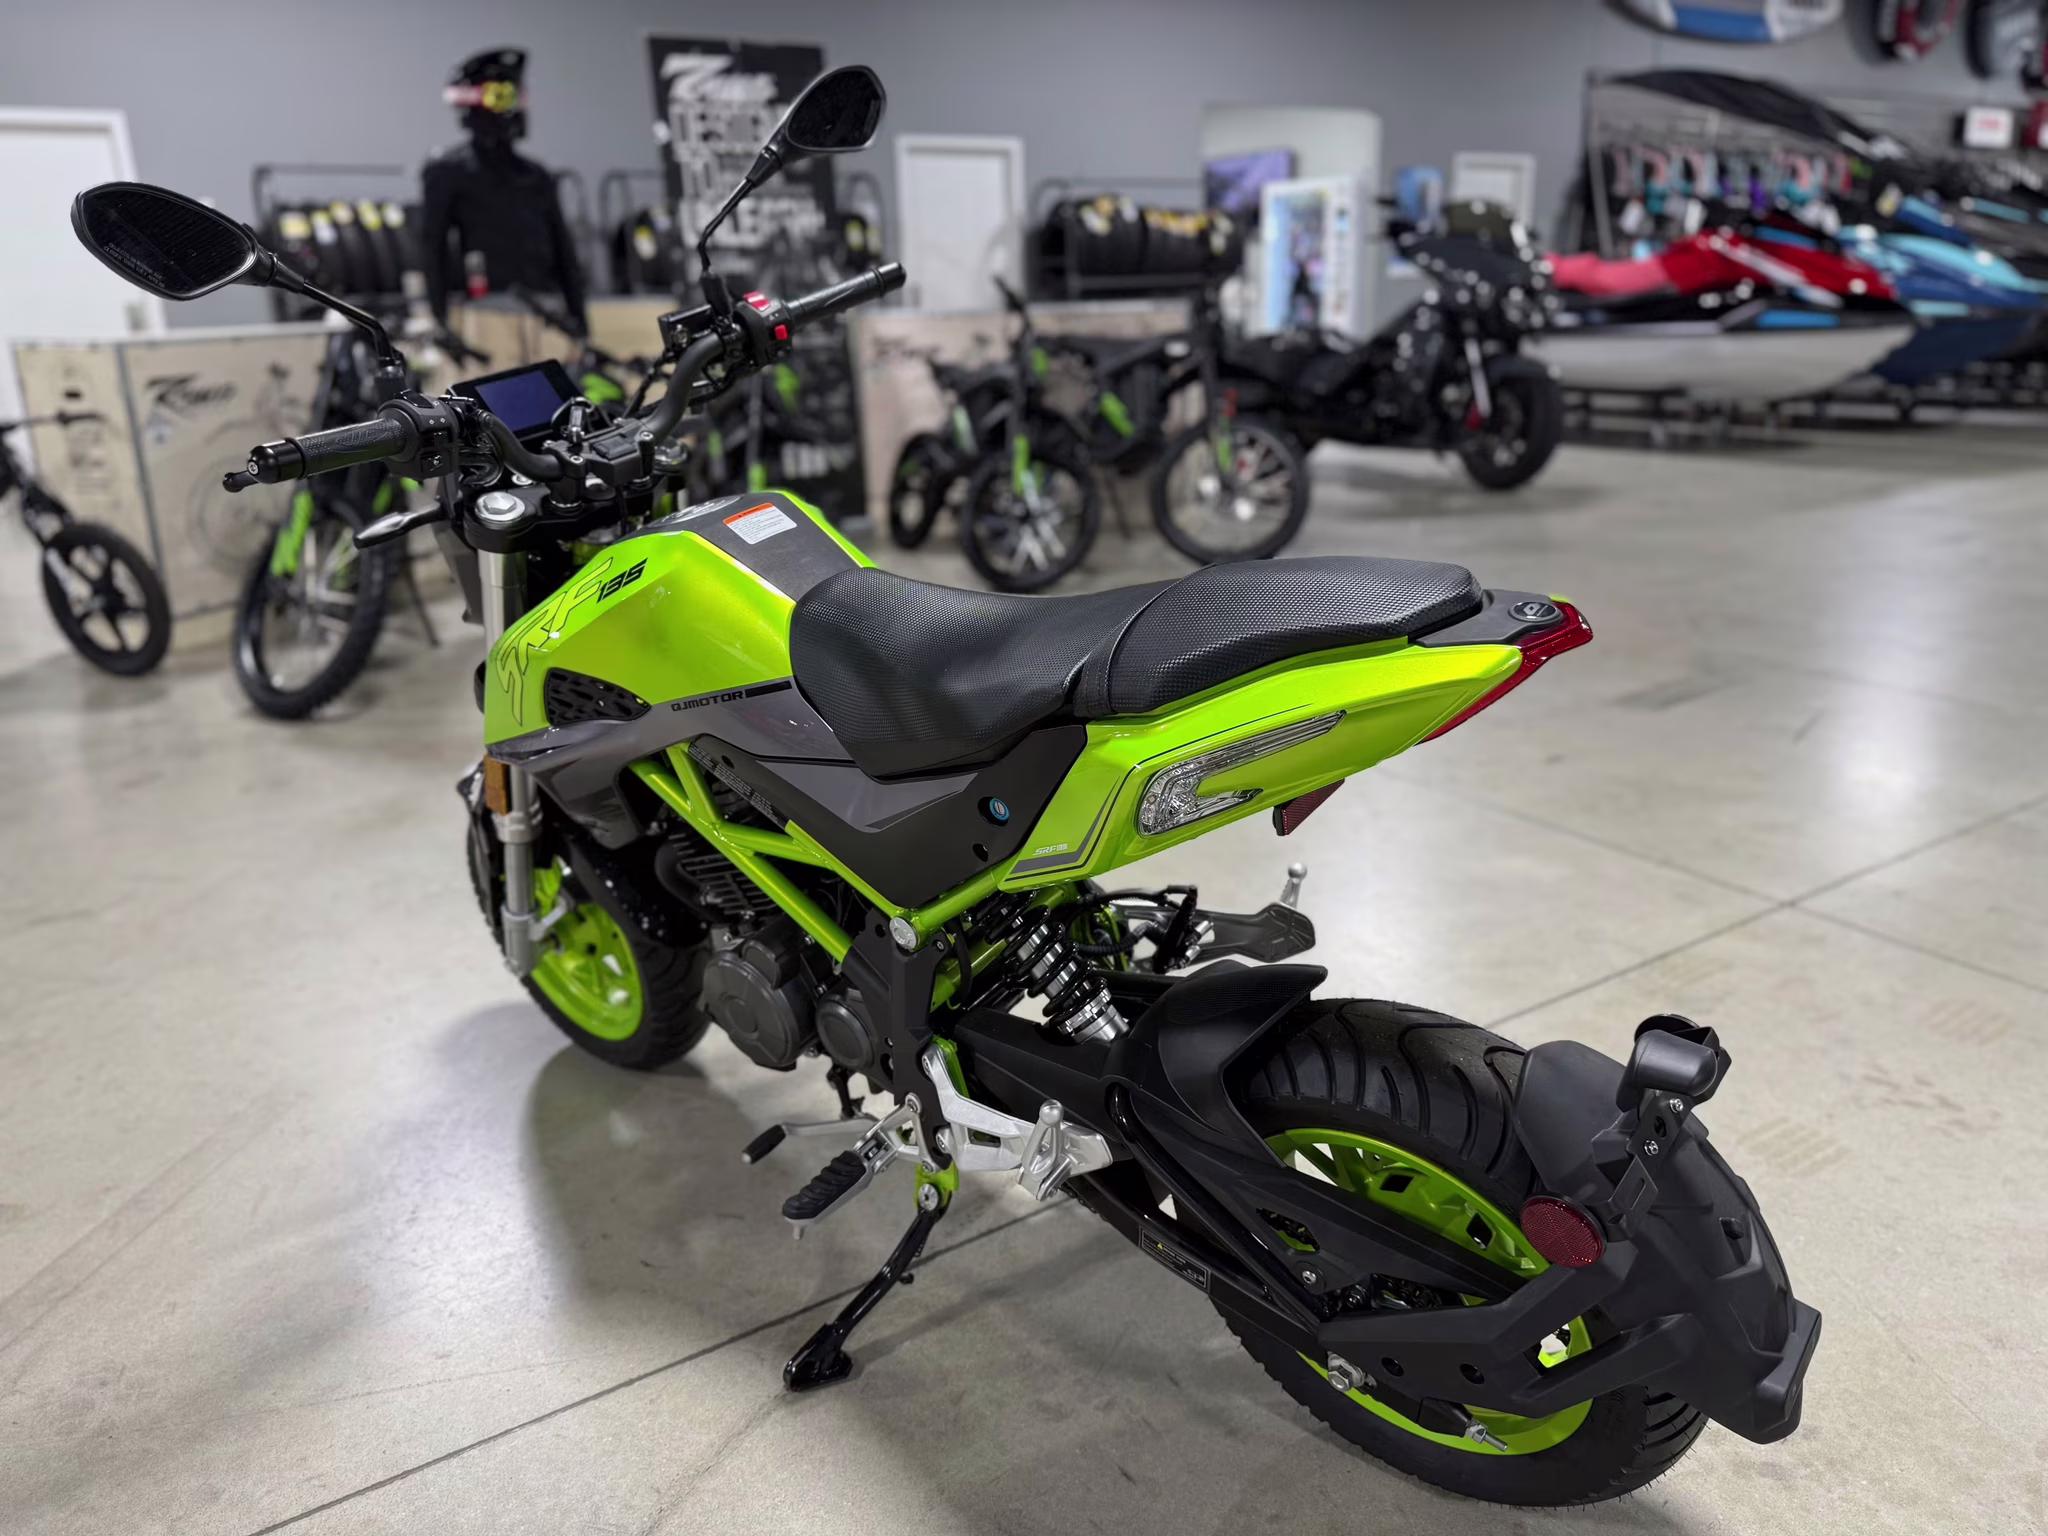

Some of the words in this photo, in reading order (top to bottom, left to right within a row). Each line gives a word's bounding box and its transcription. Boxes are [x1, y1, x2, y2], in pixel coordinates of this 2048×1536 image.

[496, 556, 613, 727] SRF
[596, 557, 648, 604] 135
[671, 690, 745, 712] QJMOTOR
